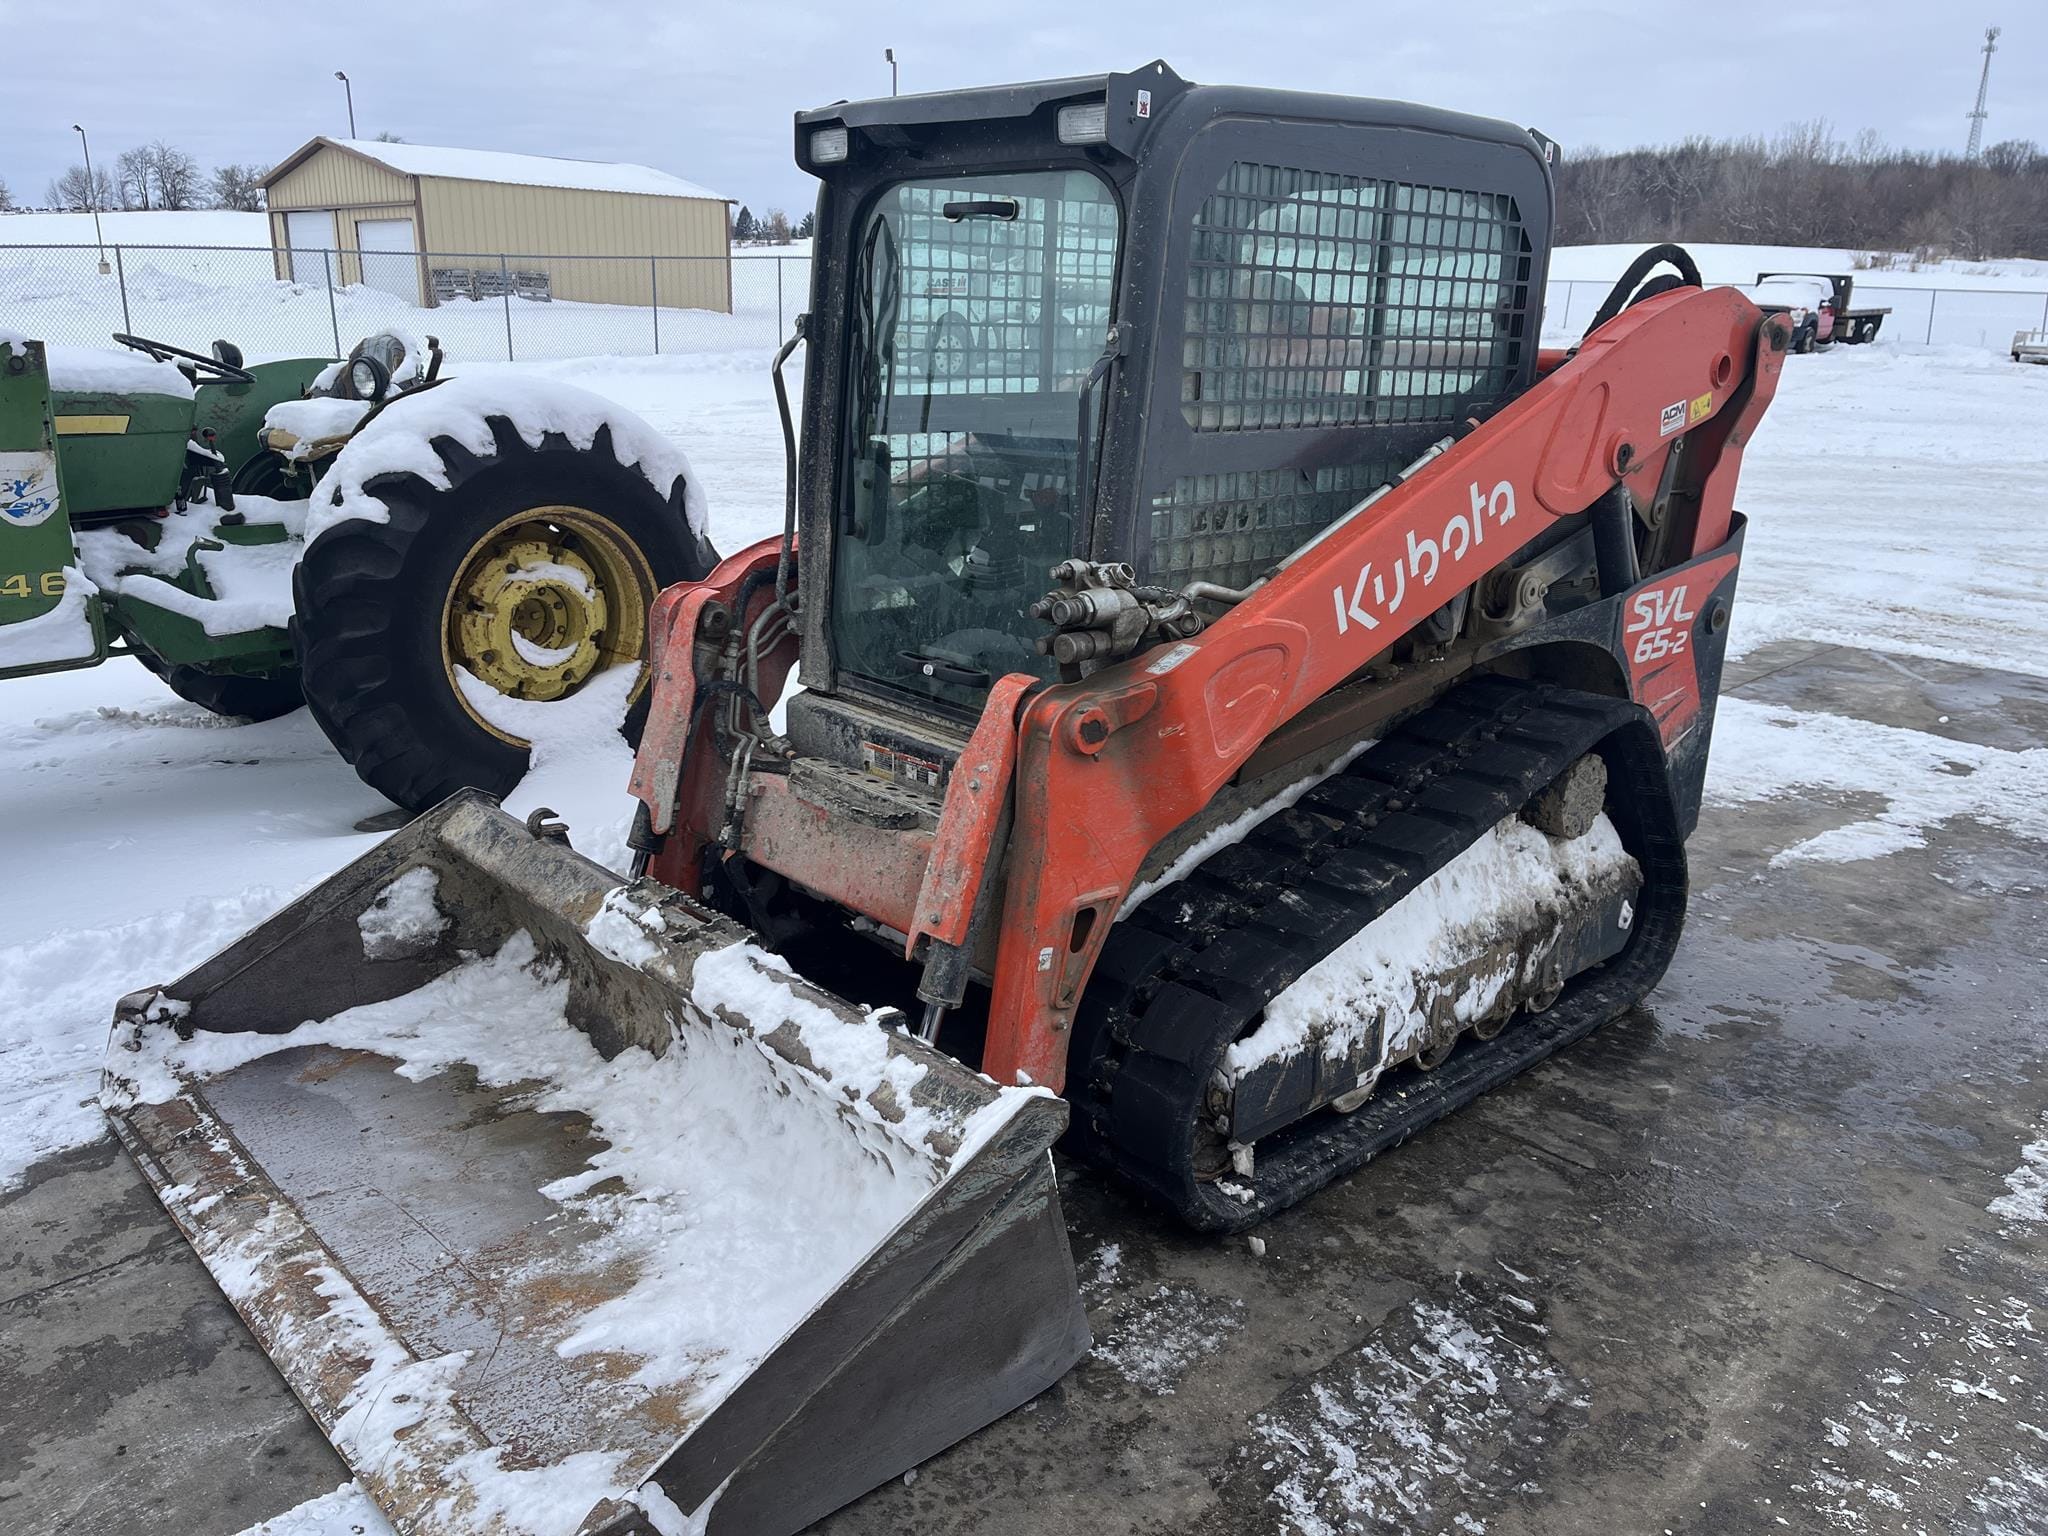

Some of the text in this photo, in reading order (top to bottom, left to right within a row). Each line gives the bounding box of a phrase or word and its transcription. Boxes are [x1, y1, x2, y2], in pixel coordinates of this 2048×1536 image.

[1662, 402, 1685, 423] ACM
[1333, 480, 1516, 635] Kubota
[1626, 585, 1694, 633] SVL
[1634, 627, 1688, 664] 65-2
